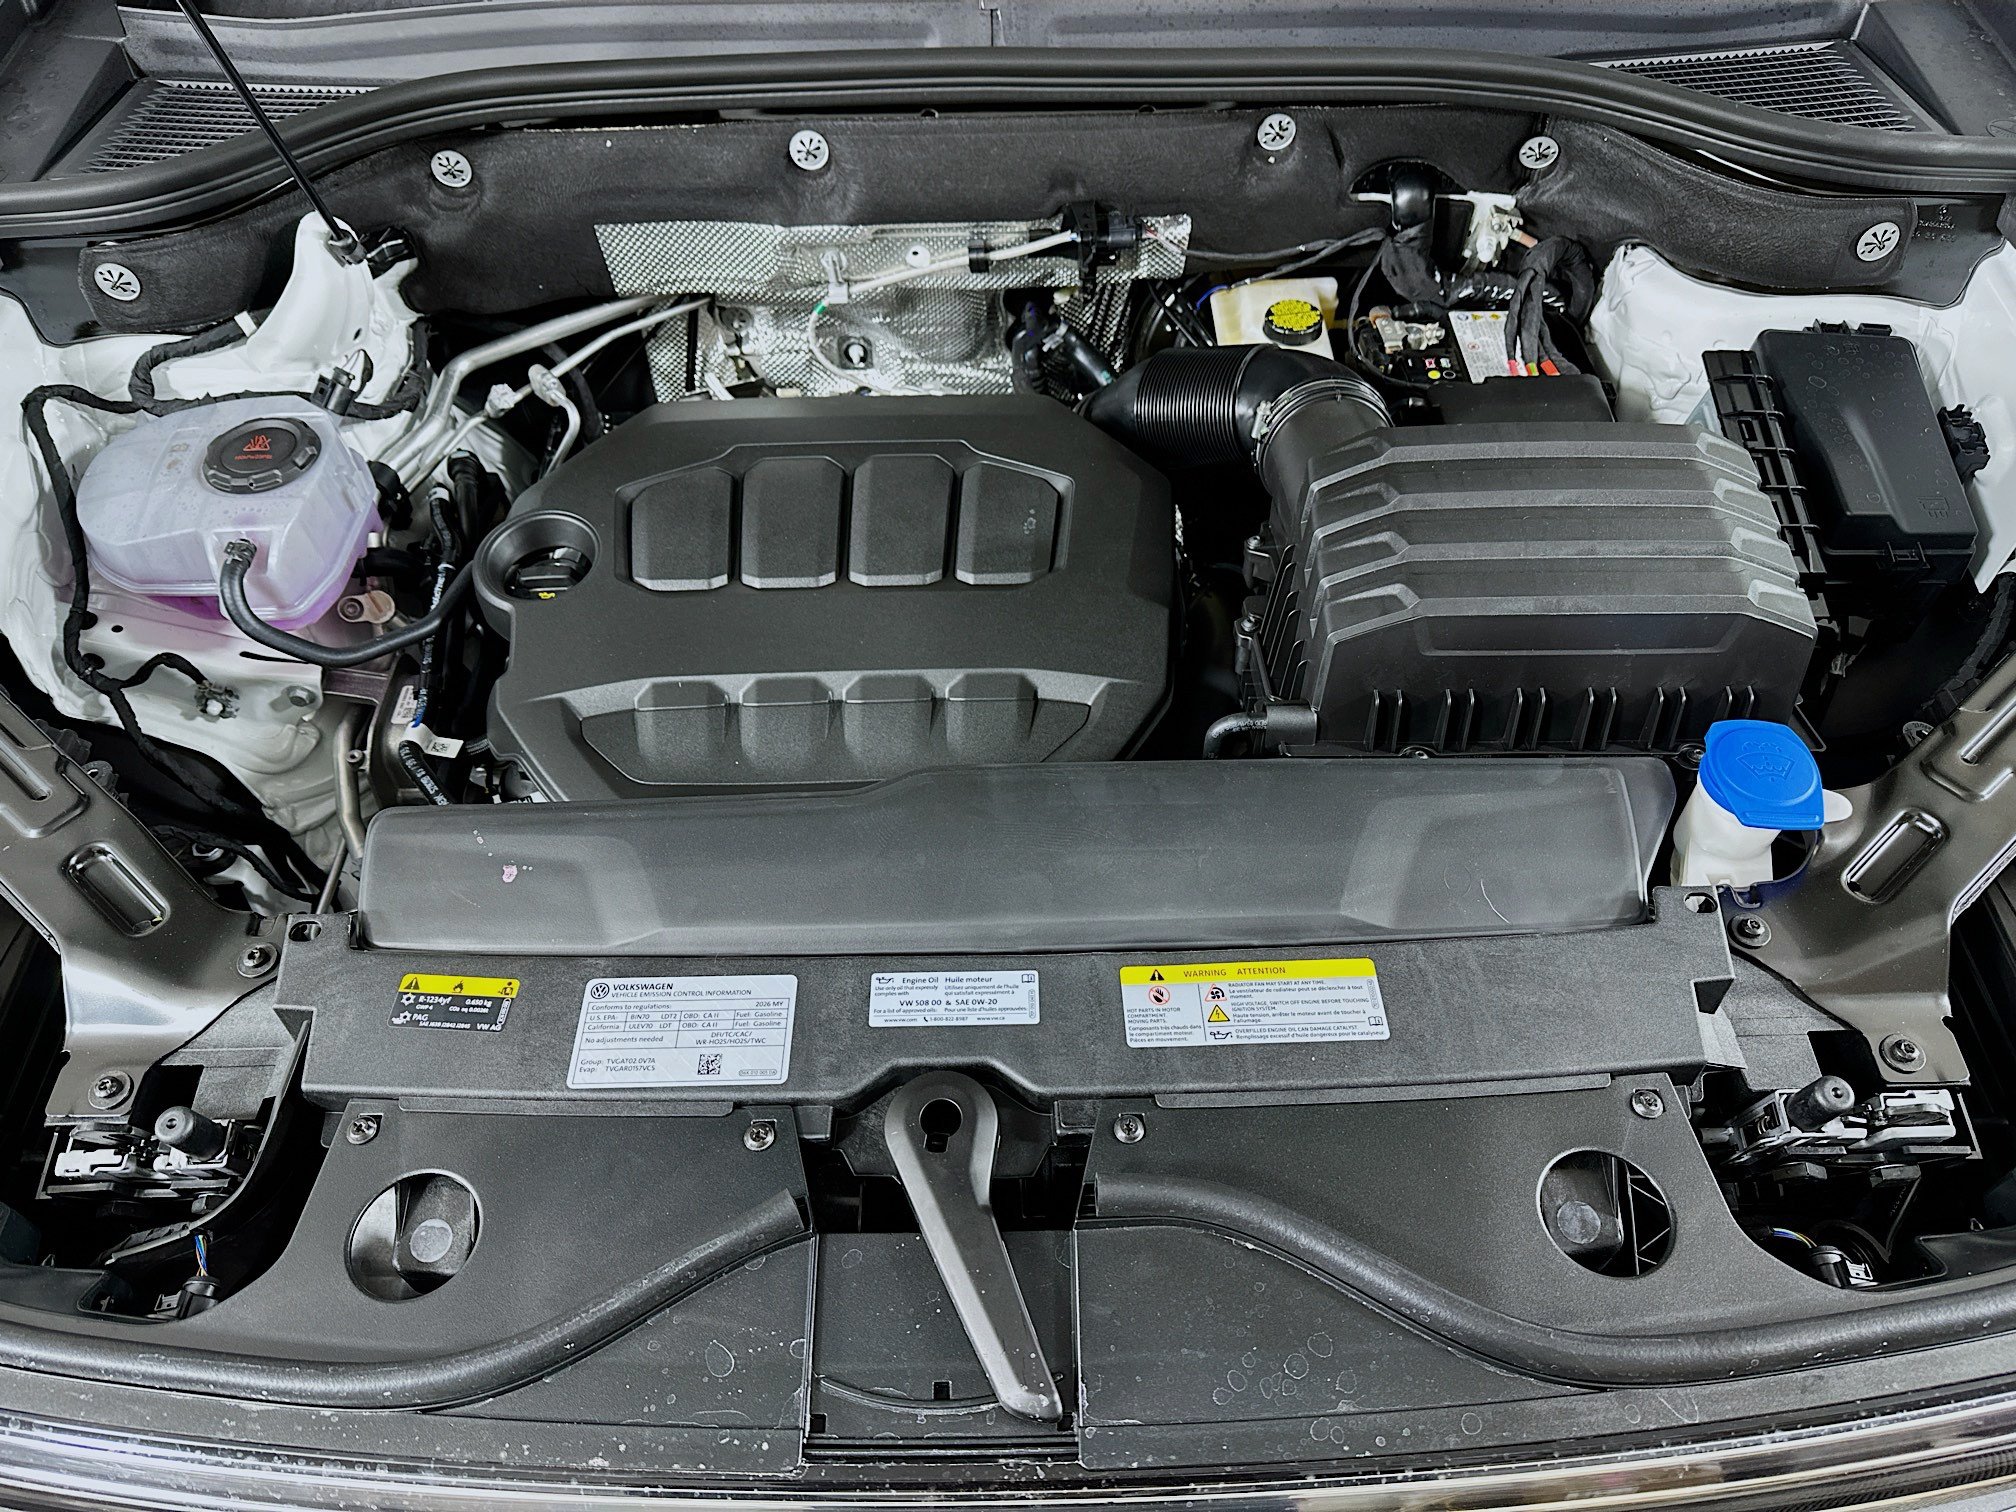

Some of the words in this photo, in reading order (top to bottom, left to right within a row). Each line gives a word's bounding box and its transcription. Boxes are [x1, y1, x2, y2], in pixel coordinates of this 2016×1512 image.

[1184, 969, 1226, 978] WARNING
[419, 995, 452, 1006] R-1234yf
[484, 1000, 492, 1008] kg
